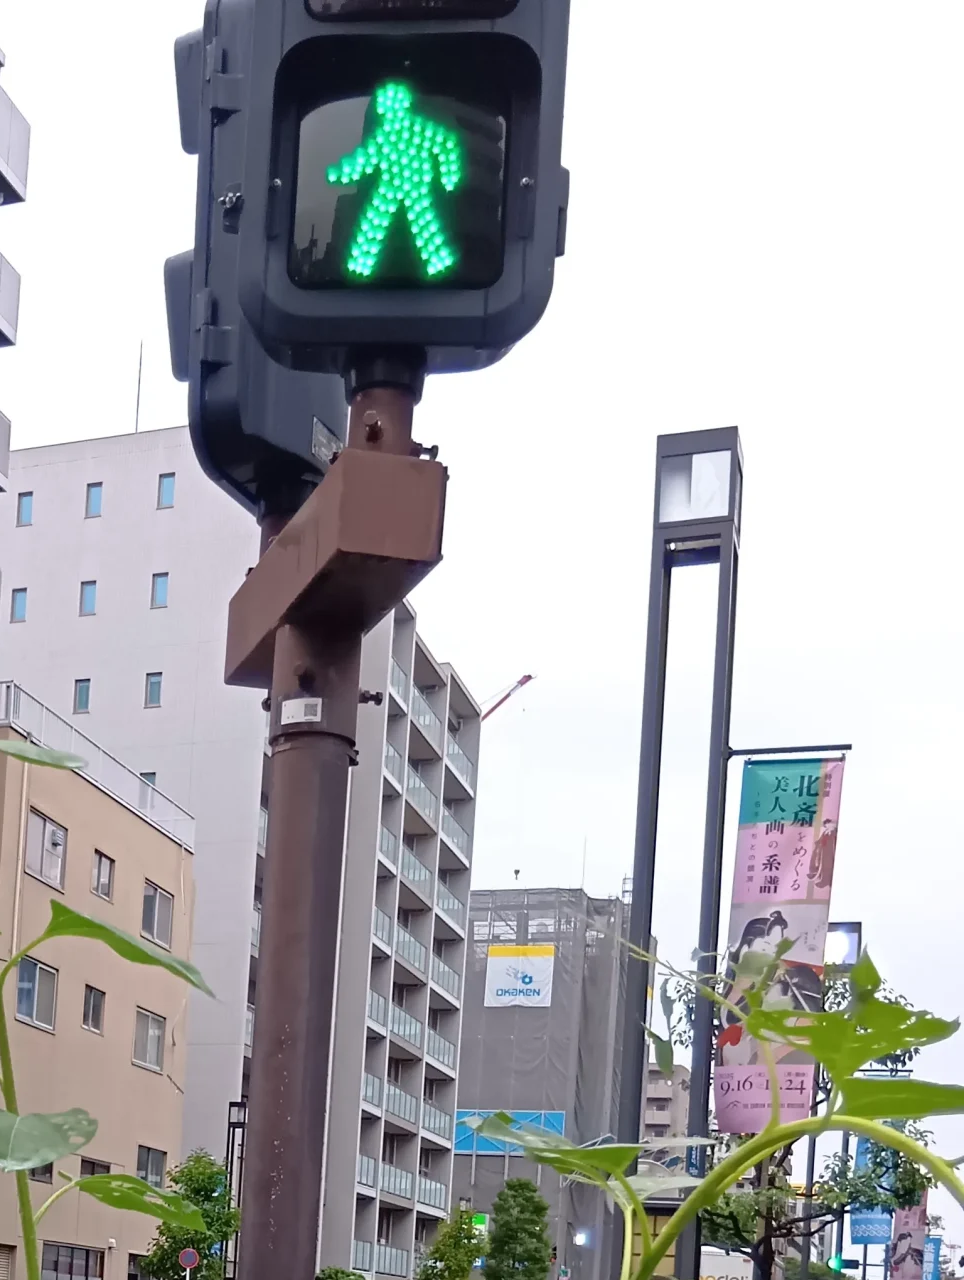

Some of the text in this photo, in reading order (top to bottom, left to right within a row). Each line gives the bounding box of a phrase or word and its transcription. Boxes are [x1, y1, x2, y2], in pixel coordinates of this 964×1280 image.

[759, 776, 789, 894] 美人画の系譜
[790, 775, 821, 891] 北斎をめぐる
[720, 1074, 807, 1097] 9.16 1.24
